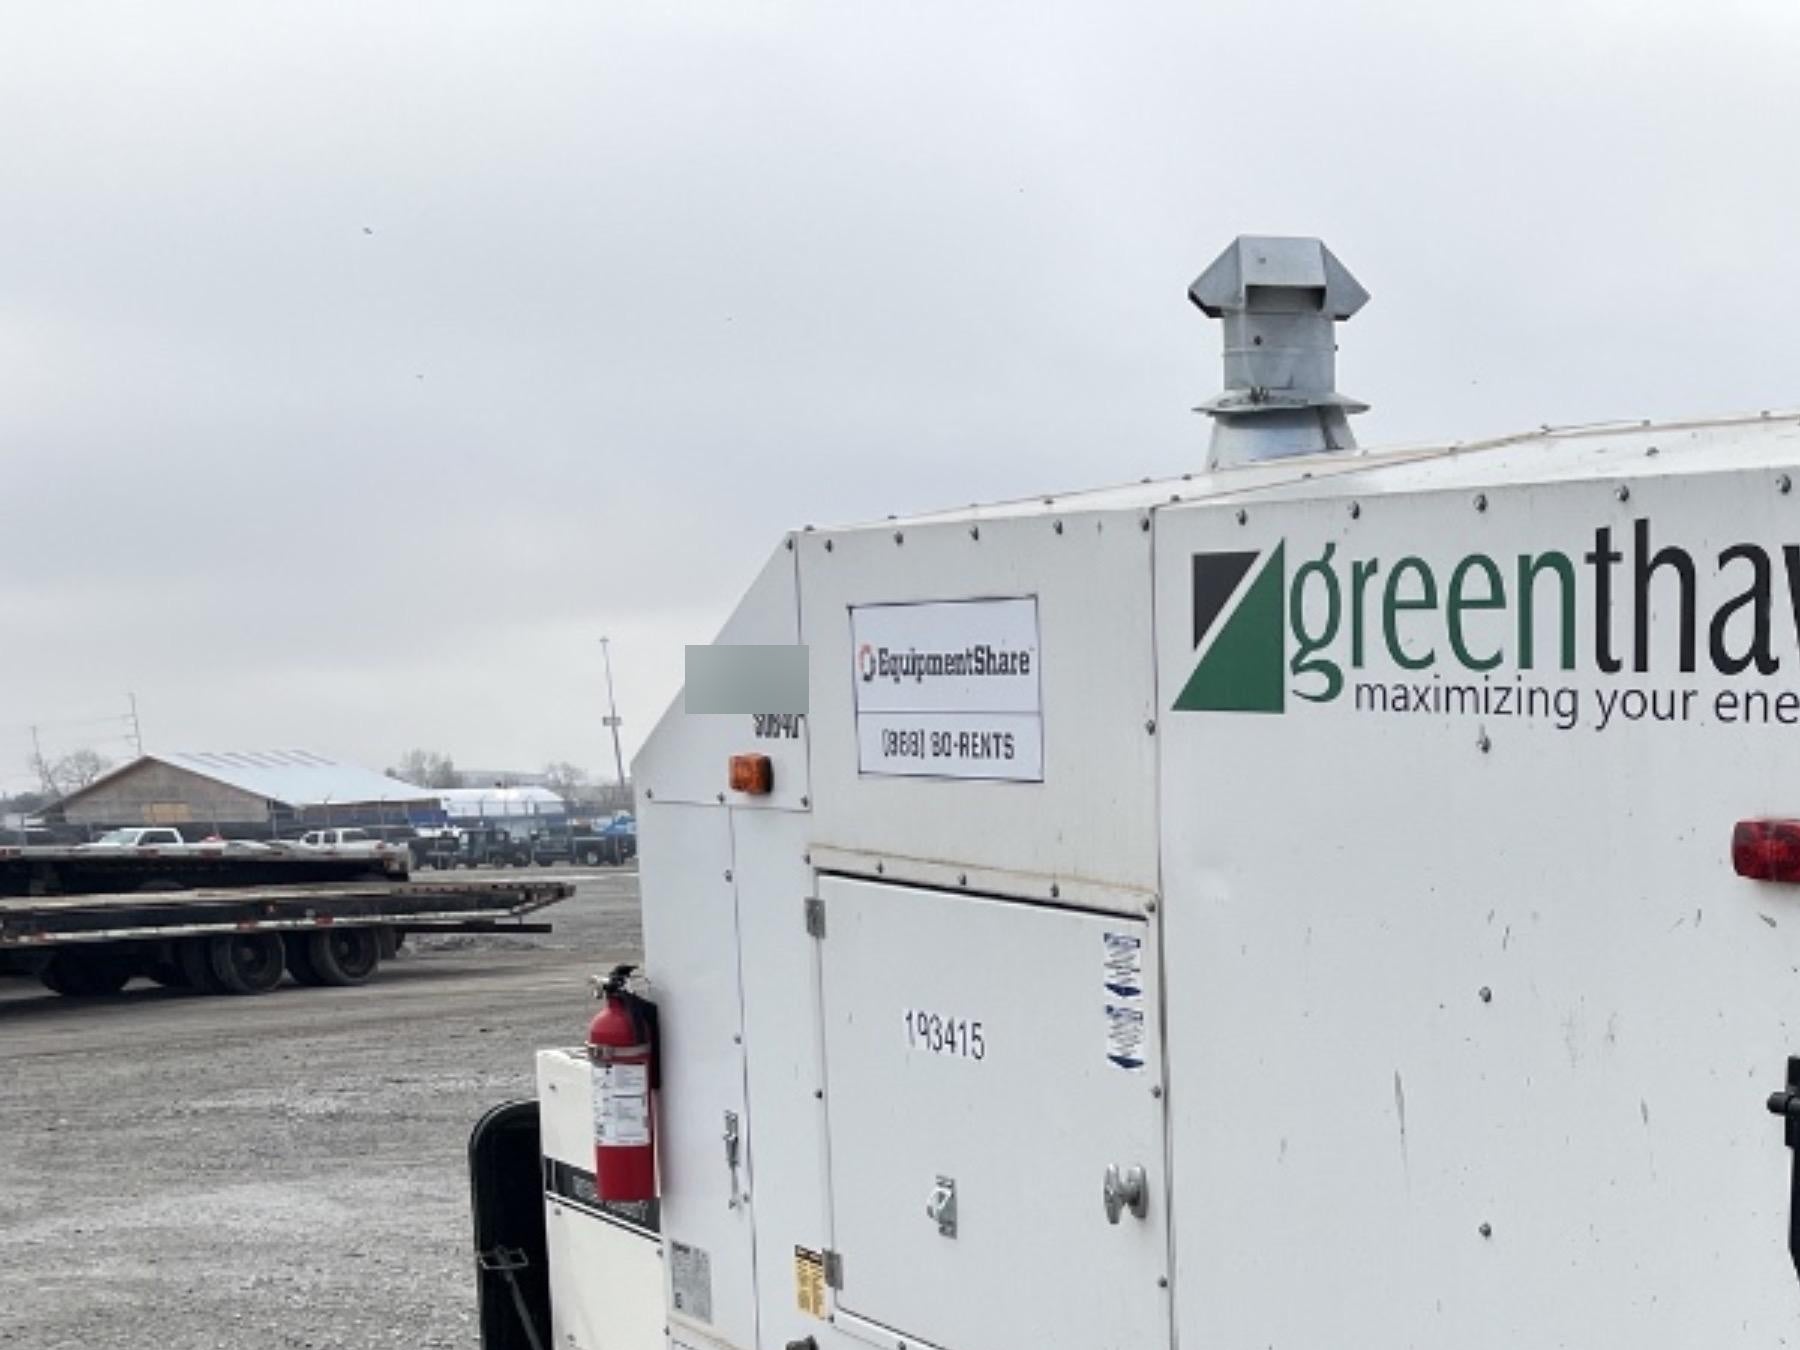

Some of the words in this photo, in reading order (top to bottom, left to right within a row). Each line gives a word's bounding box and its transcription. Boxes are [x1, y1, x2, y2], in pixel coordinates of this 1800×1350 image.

[878, 644, 1030, 684] EquipmentShare
[1354, 674, 1580, 726] maximizing
[1594, 684, 1699, 731] your
[905, 1010, 985, 1061] 193415
